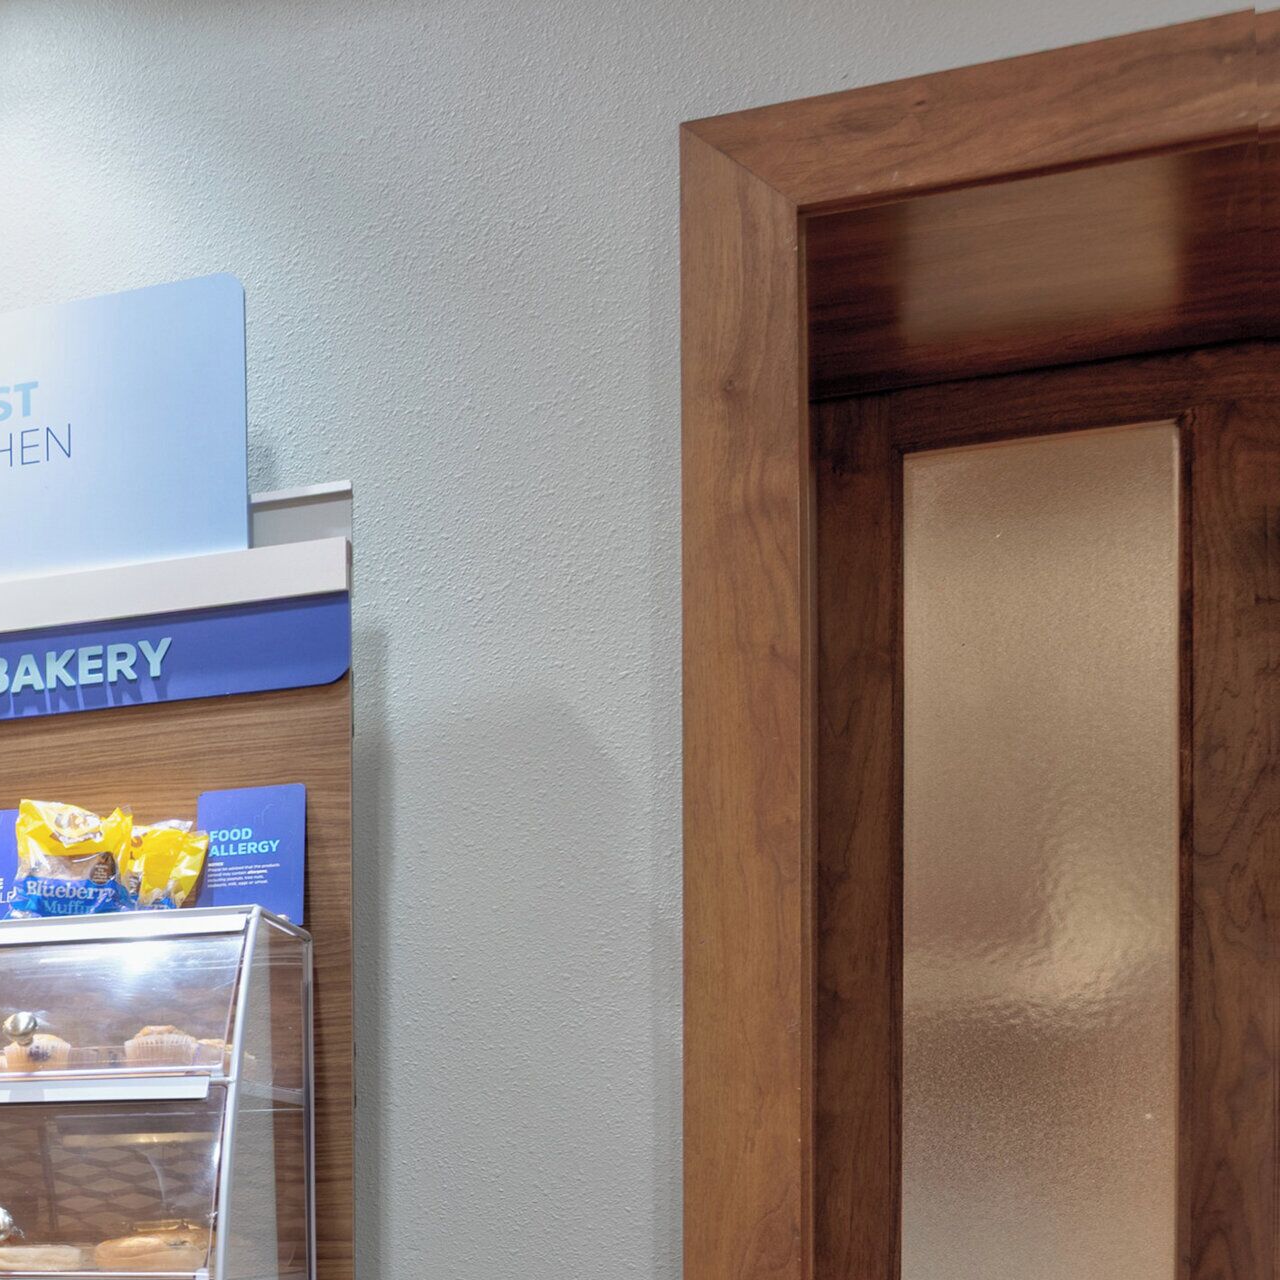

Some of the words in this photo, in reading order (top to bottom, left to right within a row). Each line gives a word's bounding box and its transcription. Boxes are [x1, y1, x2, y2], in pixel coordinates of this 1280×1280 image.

[209, 828, 252, 842] FOOD
[209, 840, 280, 857] ALLERGY
[26, 879, 116, 903] Blueberry
